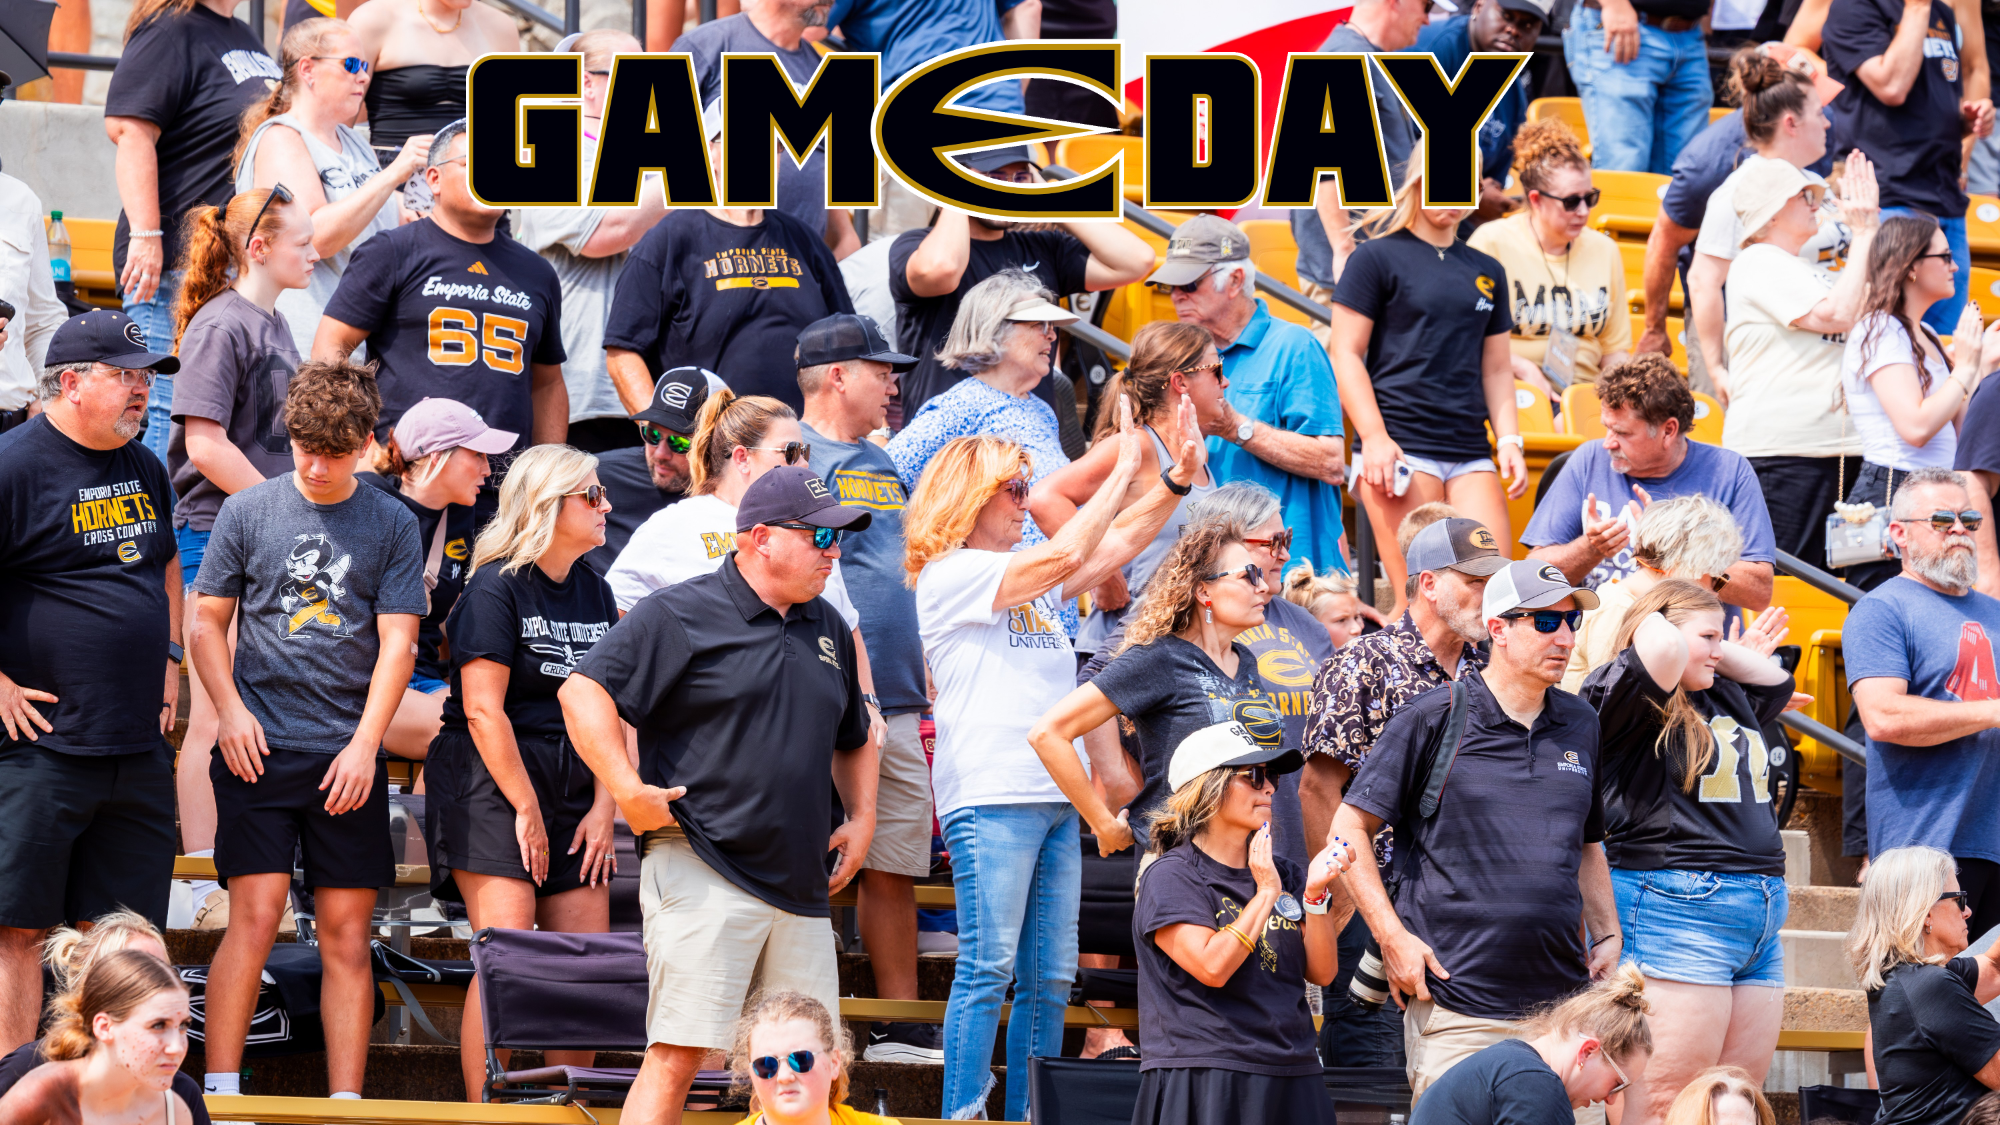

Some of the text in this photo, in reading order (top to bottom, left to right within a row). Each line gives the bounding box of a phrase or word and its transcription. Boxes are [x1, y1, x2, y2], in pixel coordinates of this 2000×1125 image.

[704, 255, 803, 278] HORNETS
[421, 276, 532, 310] Emporia State
[427, 306, 529, 375] 65
[79, 480, 142, 501] EMPORIA STATE
[836, 477, 903, 503] HORNETS
[71, 493, 156, 534] HORNETS
[84, 521, 157, 546] CROSS COUNTRY
[1773, 752, 1782, 761] 14
